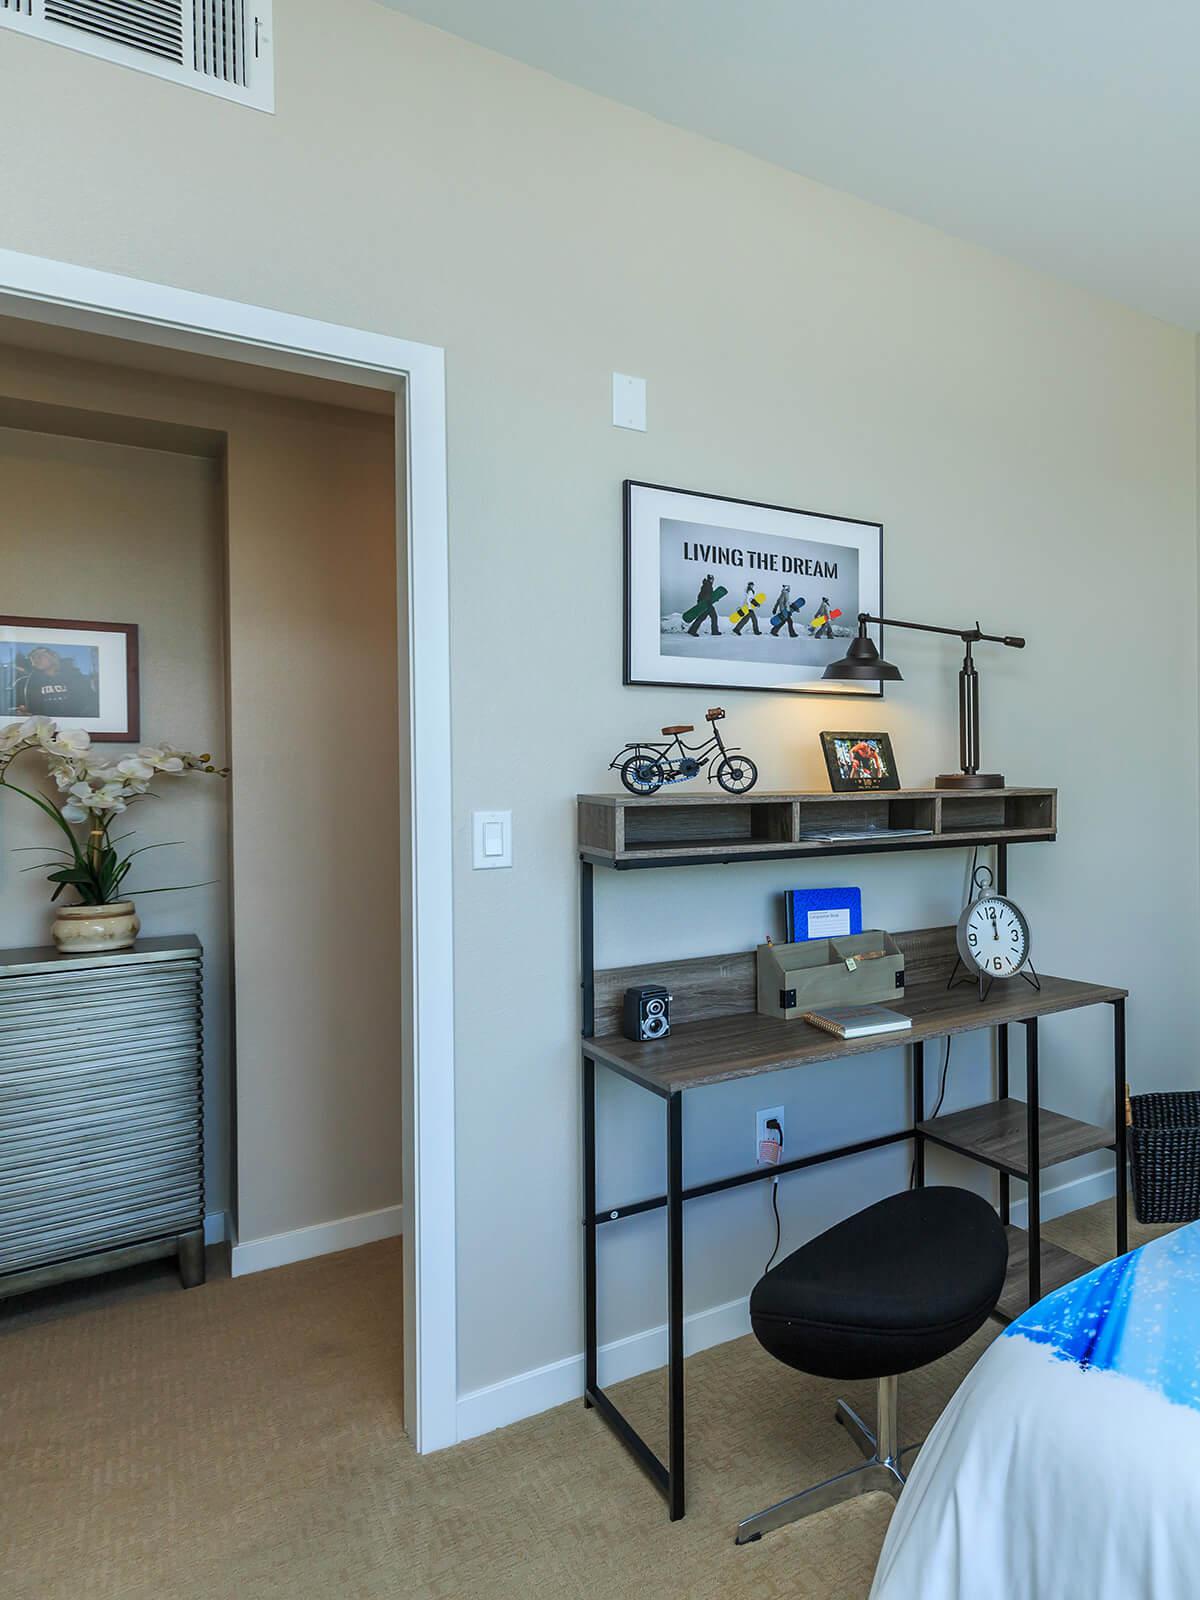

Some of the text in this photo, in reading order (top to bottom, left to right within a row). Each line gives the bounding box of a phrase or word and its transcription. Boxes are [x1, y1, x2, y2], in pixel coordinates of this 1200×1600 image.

[684, 542, 838, 579] LIVING THE DREAM
[985, 906, 997, 920] 12
[968, 933, 978, 946] 9
[1011, 929, 1019, 942] 3
[993, 956, 1002, 970] 6
